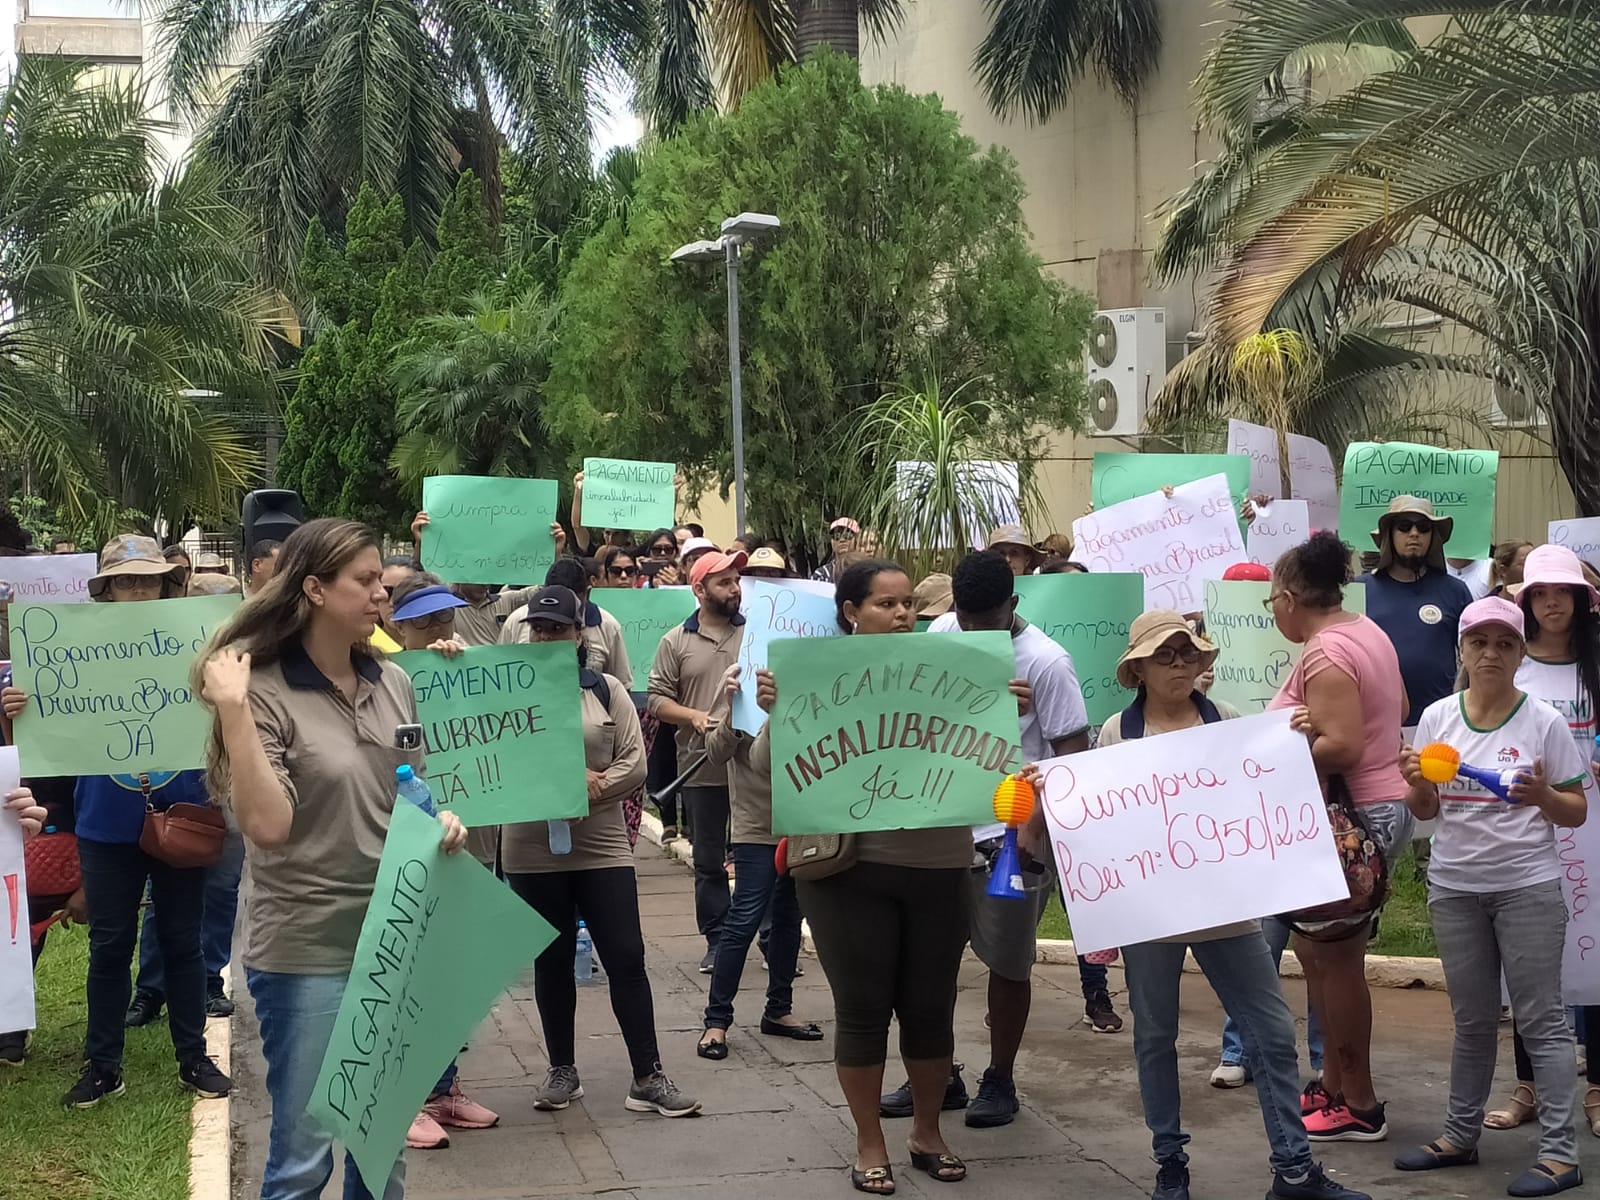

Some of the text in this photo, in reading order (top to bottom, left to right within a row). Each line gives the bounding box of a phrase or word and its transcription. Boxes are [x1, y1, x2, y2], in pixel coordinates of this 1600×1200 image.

[1119, 314, 1136, 323] ELGIN
[587, 460, 671, 484] PAGAMENTO
[1350, 447, 1485, 475] PAGAMENTO
[425, 483, 553, 526] Cumpra a
[1073, 516, 1195, 562] Pagamento
[1164, 526, 1241, 575] Brasil
[10, 606, 184, 689] Pagamento
[27, 667, 132, 719] Previne
[783, 662, 1000, 734] PAGAMENTO
[784, 712, 1023, 793] INSALUBRIDADE
[427, 753, 503, 805] JÁ !!!
[849, 765, 955, 820] Já !!!
[1043, 758, 1276, 830] Cumpra a
[1167, 791, 1320, 869] 6950/22
[1577, 935, 1595, 961] a
[328, 859, 428, 1121] PAGAMENTO
